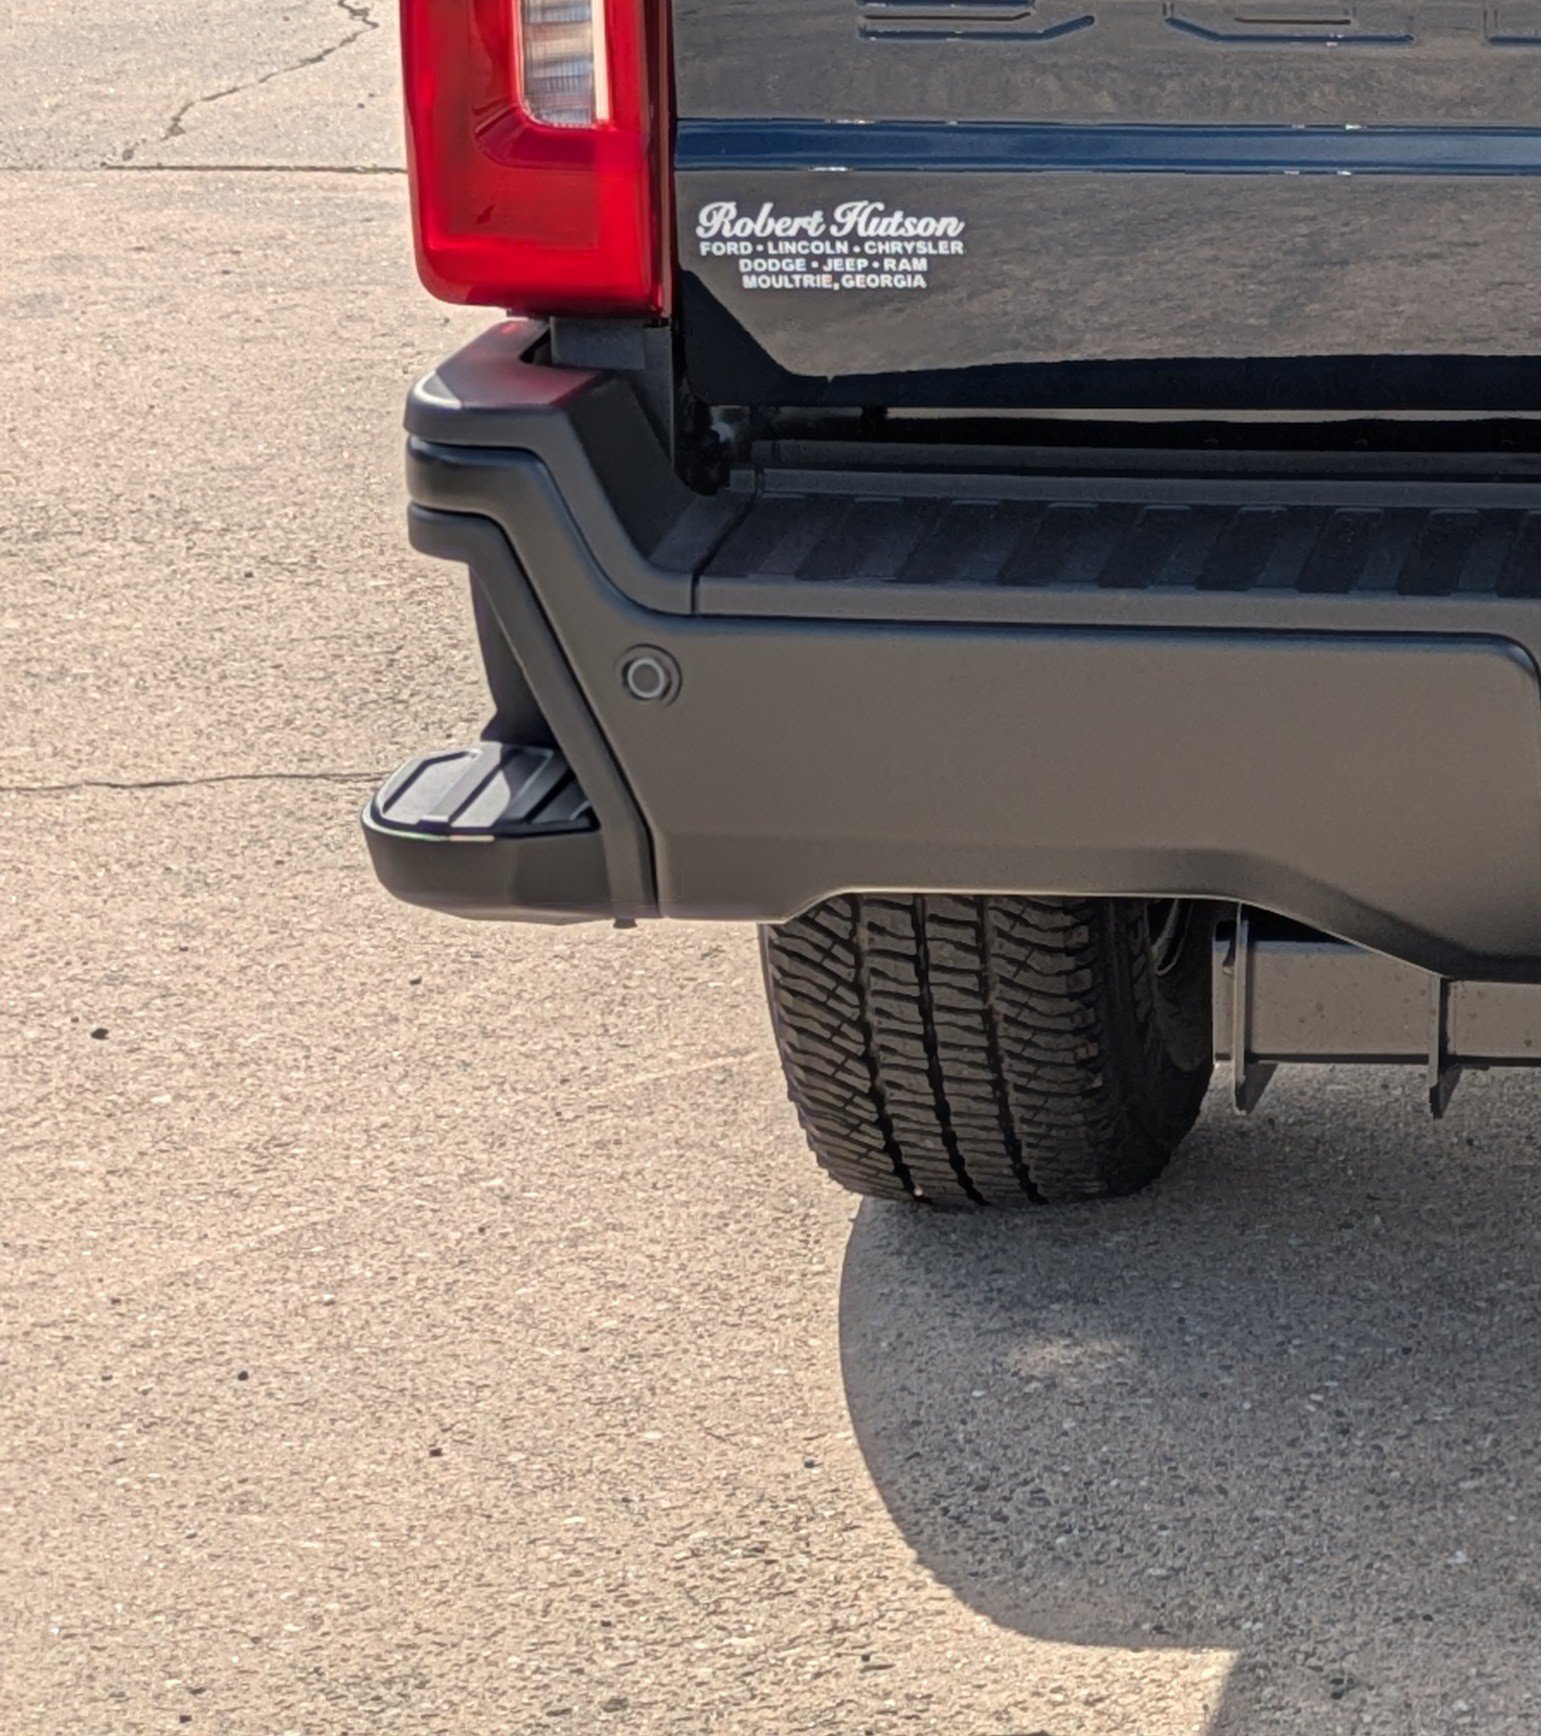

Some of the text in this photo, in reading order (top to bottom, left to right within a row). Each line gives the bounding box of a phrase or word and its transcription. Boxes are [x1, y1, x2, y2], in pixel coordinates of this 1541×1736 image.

[695, 199, 966, 239] Robert Hutson
[699, 240, 964, 256] FORD LINCOLN CHRYSLER
[738, 257, 928, 272] DODGE JEEP RAM
[742, 274, 928, 290] MOULTRIE, GEORGIA
